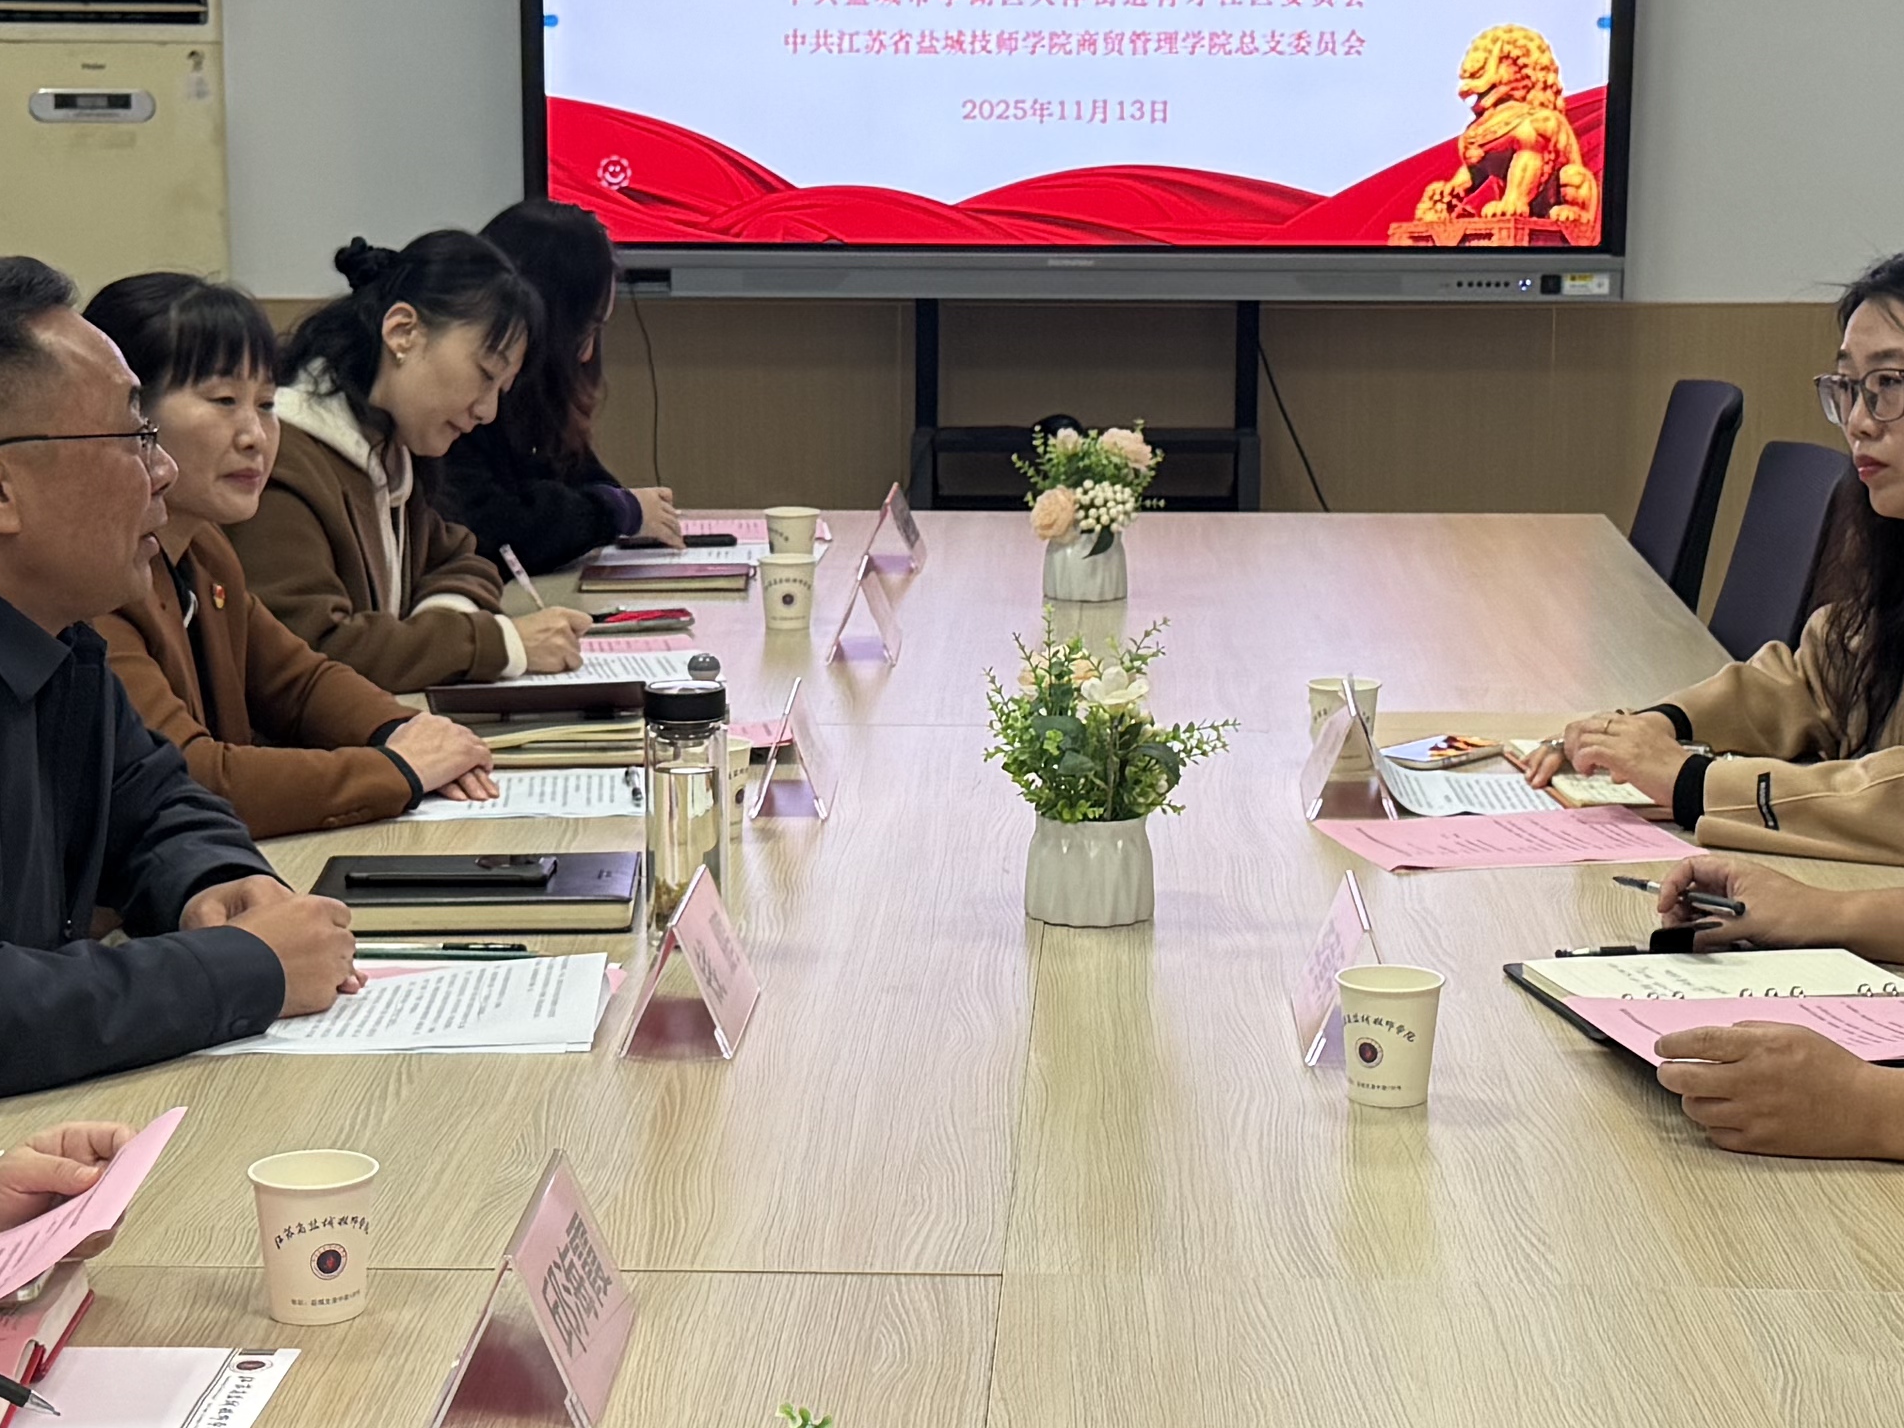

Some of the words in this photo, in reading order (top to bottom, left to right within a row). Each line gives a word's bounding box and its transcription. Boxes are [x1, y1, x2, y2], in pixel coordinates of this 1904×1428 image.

[782, 26, 1368, 58] 中共江苏省盐城技师学院商贸管理学院总支委员会
[962, 97, 1171, 125] 2025年11月13日
[541, 1210, 613, 1357] 邱海霞
